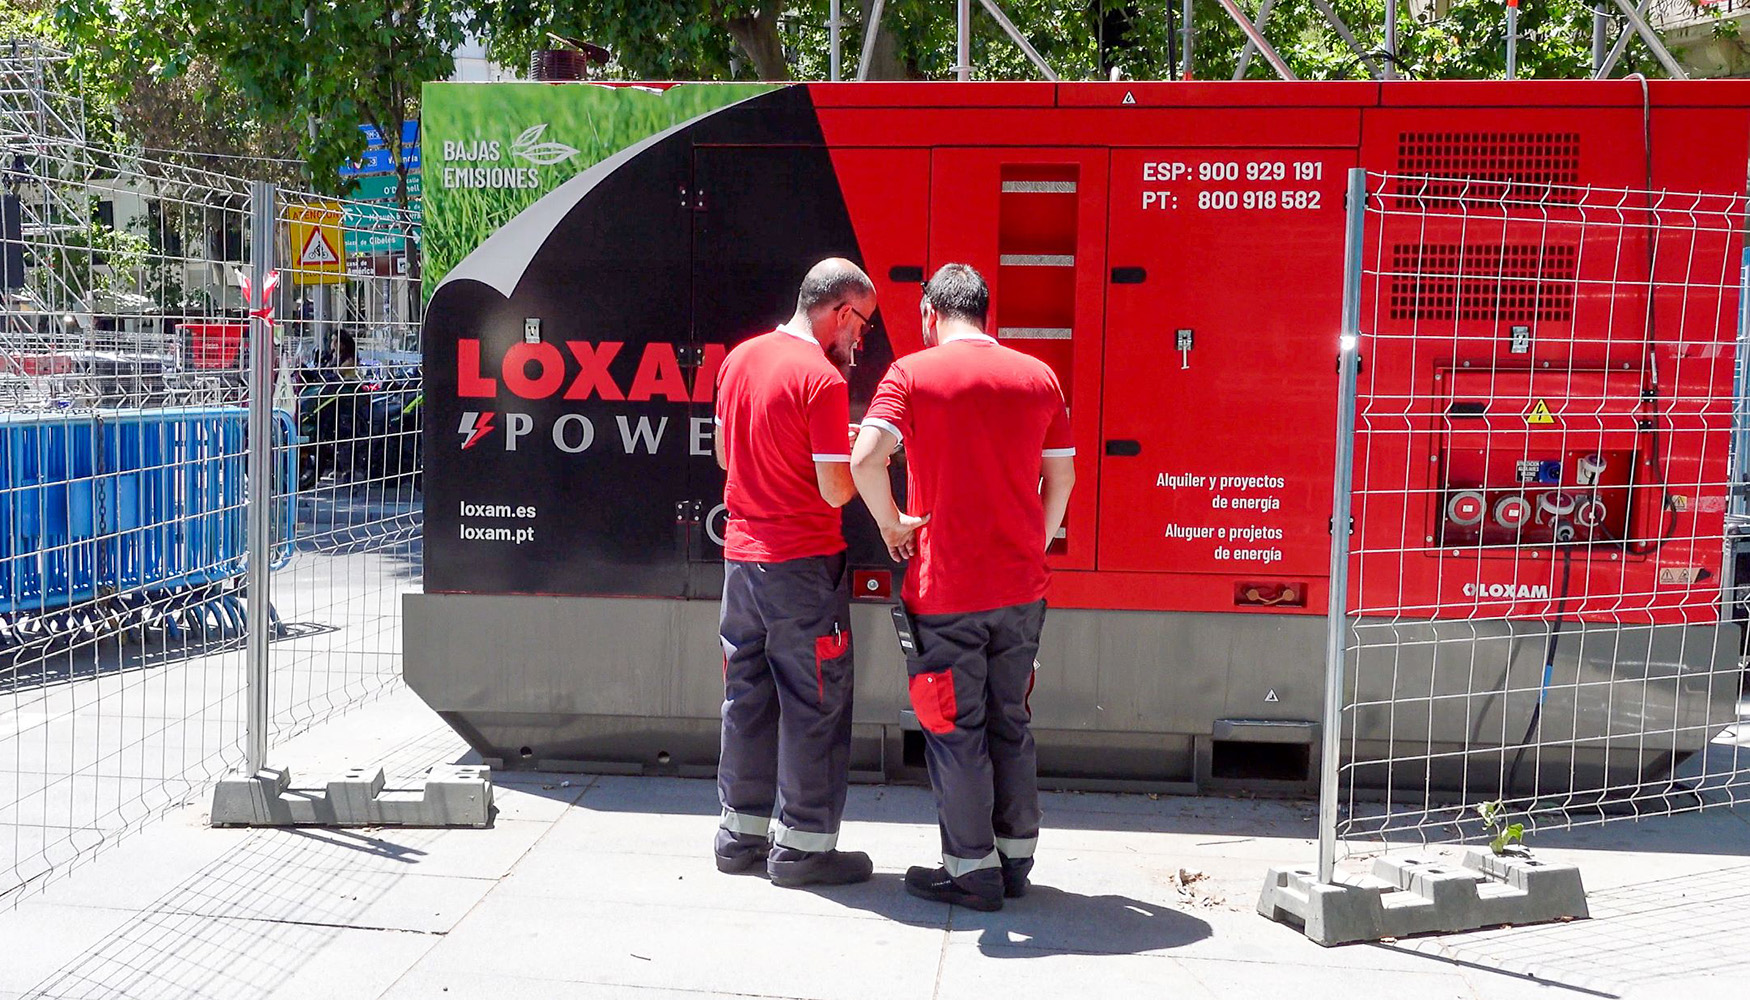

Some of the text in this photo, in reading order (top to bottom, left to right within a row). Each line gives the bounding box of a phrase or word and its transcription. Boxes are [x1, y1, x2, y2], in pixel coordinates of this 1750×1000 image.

[444, 141, 500, 161] BAJAS
[443, 168, 539, 189] EMISIONES
[1143, 161, 1322, 181] ESP: 900 929 191
[1142, 191, 1321, 210] PT: 800 918 582
[505, 413, 713, 456] POWE
[1156, 472, 1285, 491] Alquiler y proyectos
[460, 501, 537, 518] loxam.es
[1212, 494, 1280, 512] de energía
[460, 524, 534, 544] loxam.pt
[1165, 523, 1283, 542] Aluguer e projetos
[1214, 545, 1282, 564] de energía
[1479, 583, 1549, 599] LOXAM
